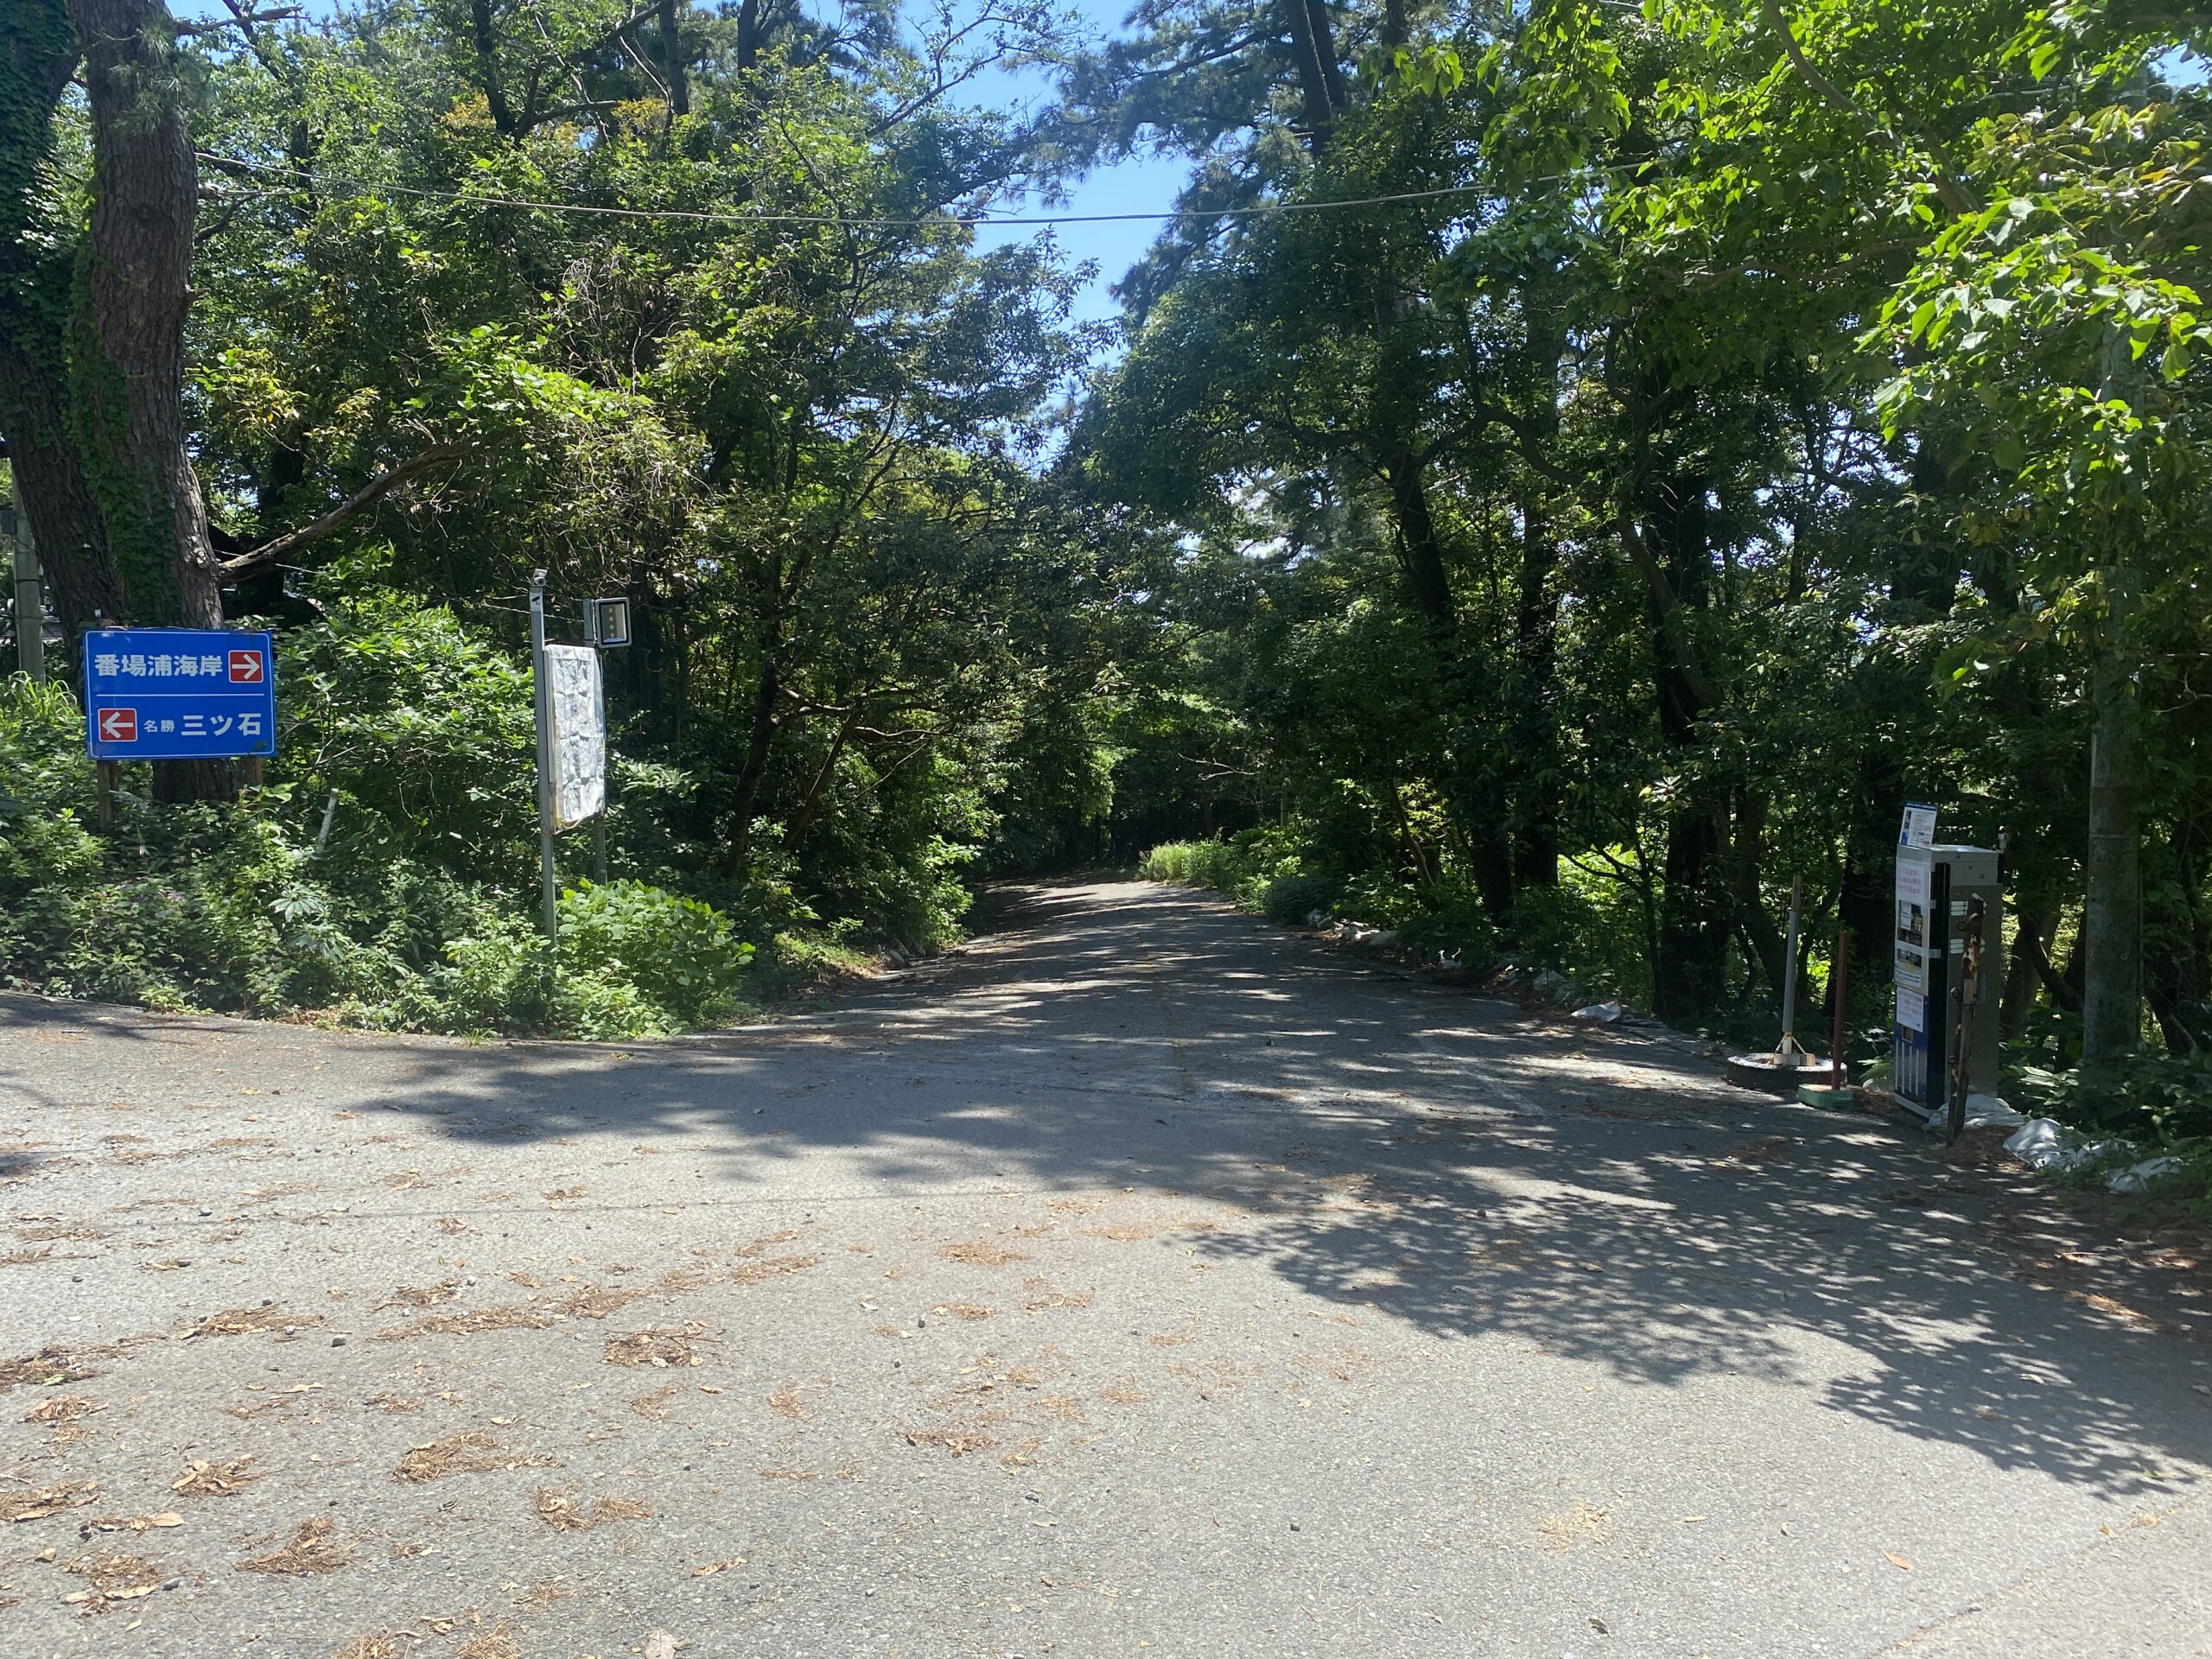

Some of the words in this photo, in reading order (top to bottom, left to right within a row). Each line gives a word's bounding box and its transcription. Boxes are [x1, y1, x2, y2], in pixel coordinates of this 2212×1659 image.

[94, 654, 223, 677] 番場浦海岸
[143, 720, 175, 733] 名勝
[181, 713, 261, 736] 三ツ石
